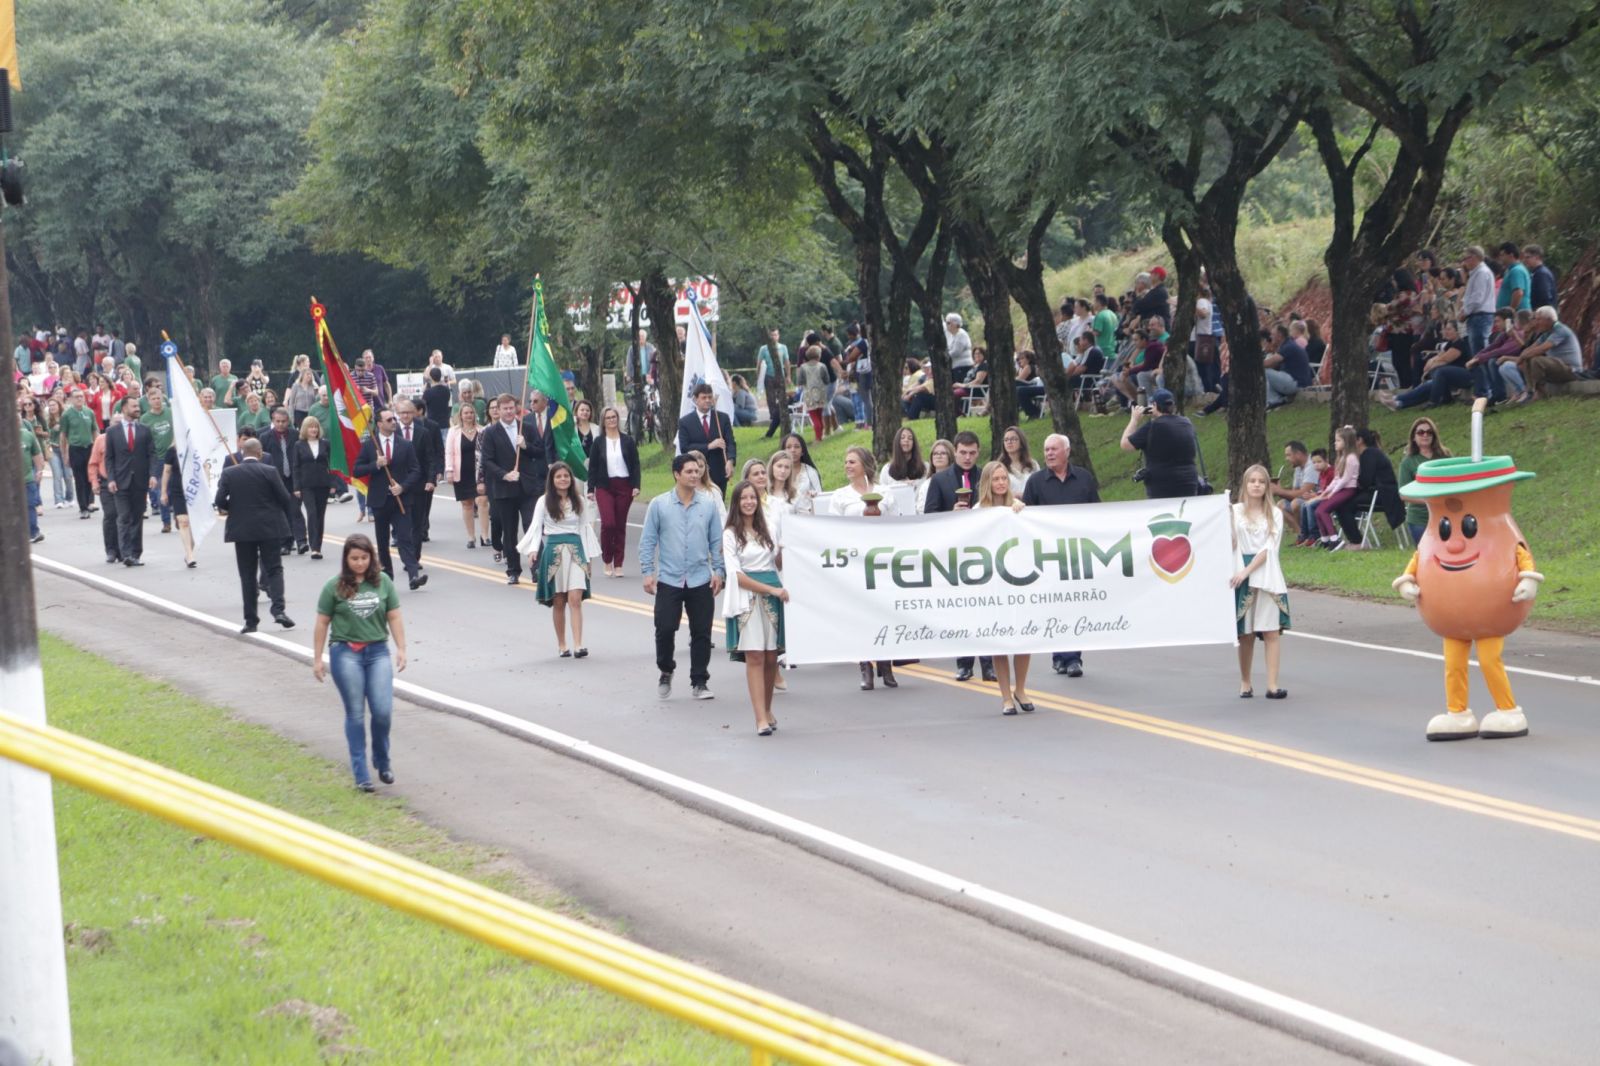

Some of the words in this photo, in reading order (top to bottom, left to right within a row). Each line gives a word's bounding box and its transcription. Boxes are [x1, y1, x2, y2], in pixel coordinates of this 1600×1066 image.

[895, 599, 932, 610] FESTA
[937, 595, 1002, 609] NACIONAL
[1008, 594, 1025, 605] DO
[1030, 588, 1108, 604] CHIMARRÃO
[873, 625, 889, 646] A
[894, 624, 936, 645] Festa
[939, 629, 971, 640] com
[975, 621, 1016, 638] sabor
[1020, 620, 1040, 636] do
[1043, 616, 1071, 639] Rio
[1074, 615, 1131, 636] Grande
